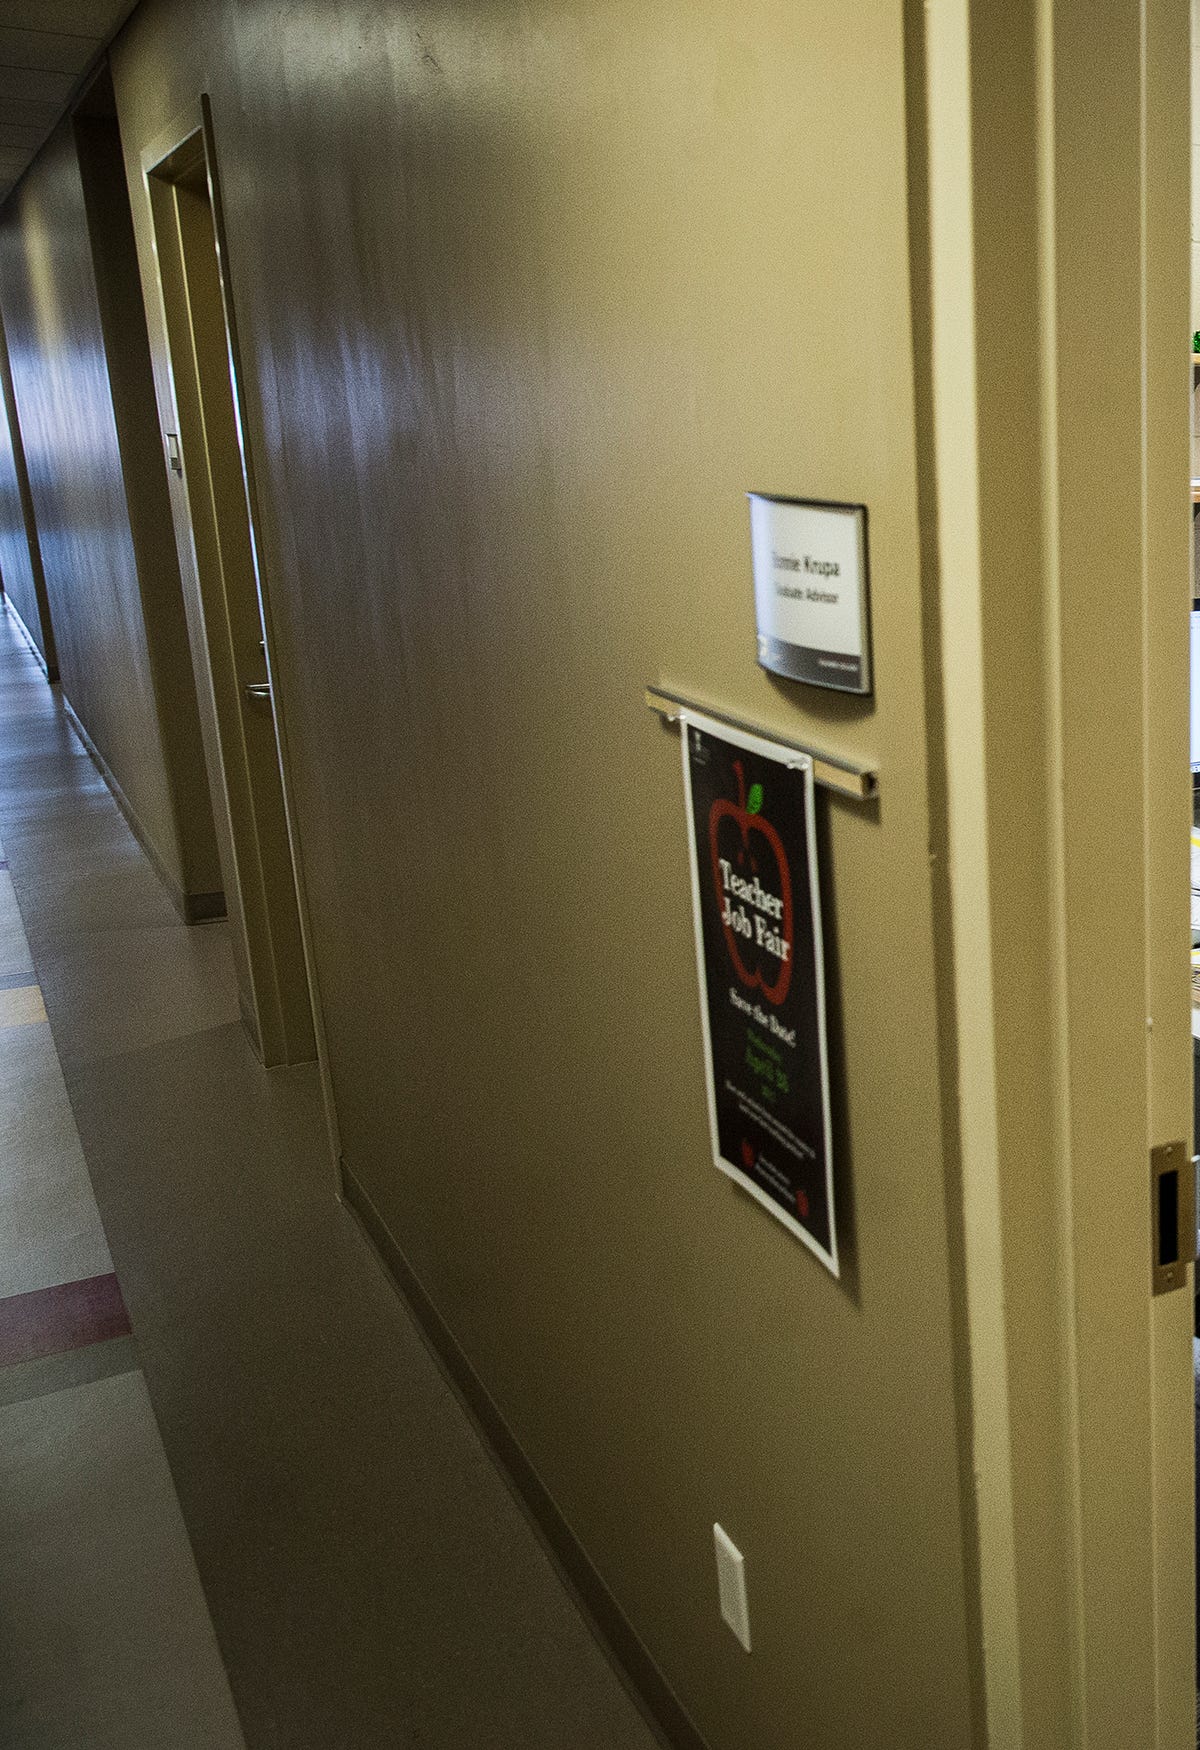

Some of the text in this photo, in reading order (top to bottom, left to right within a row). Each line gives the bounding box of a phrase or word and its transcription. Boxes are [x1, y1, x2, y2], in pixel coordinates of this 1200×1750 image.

[803, 555, 840, 580] Krupa
[719, 858, 784, 920] Teacher
[722, 896, 790, 961] Job Fair
